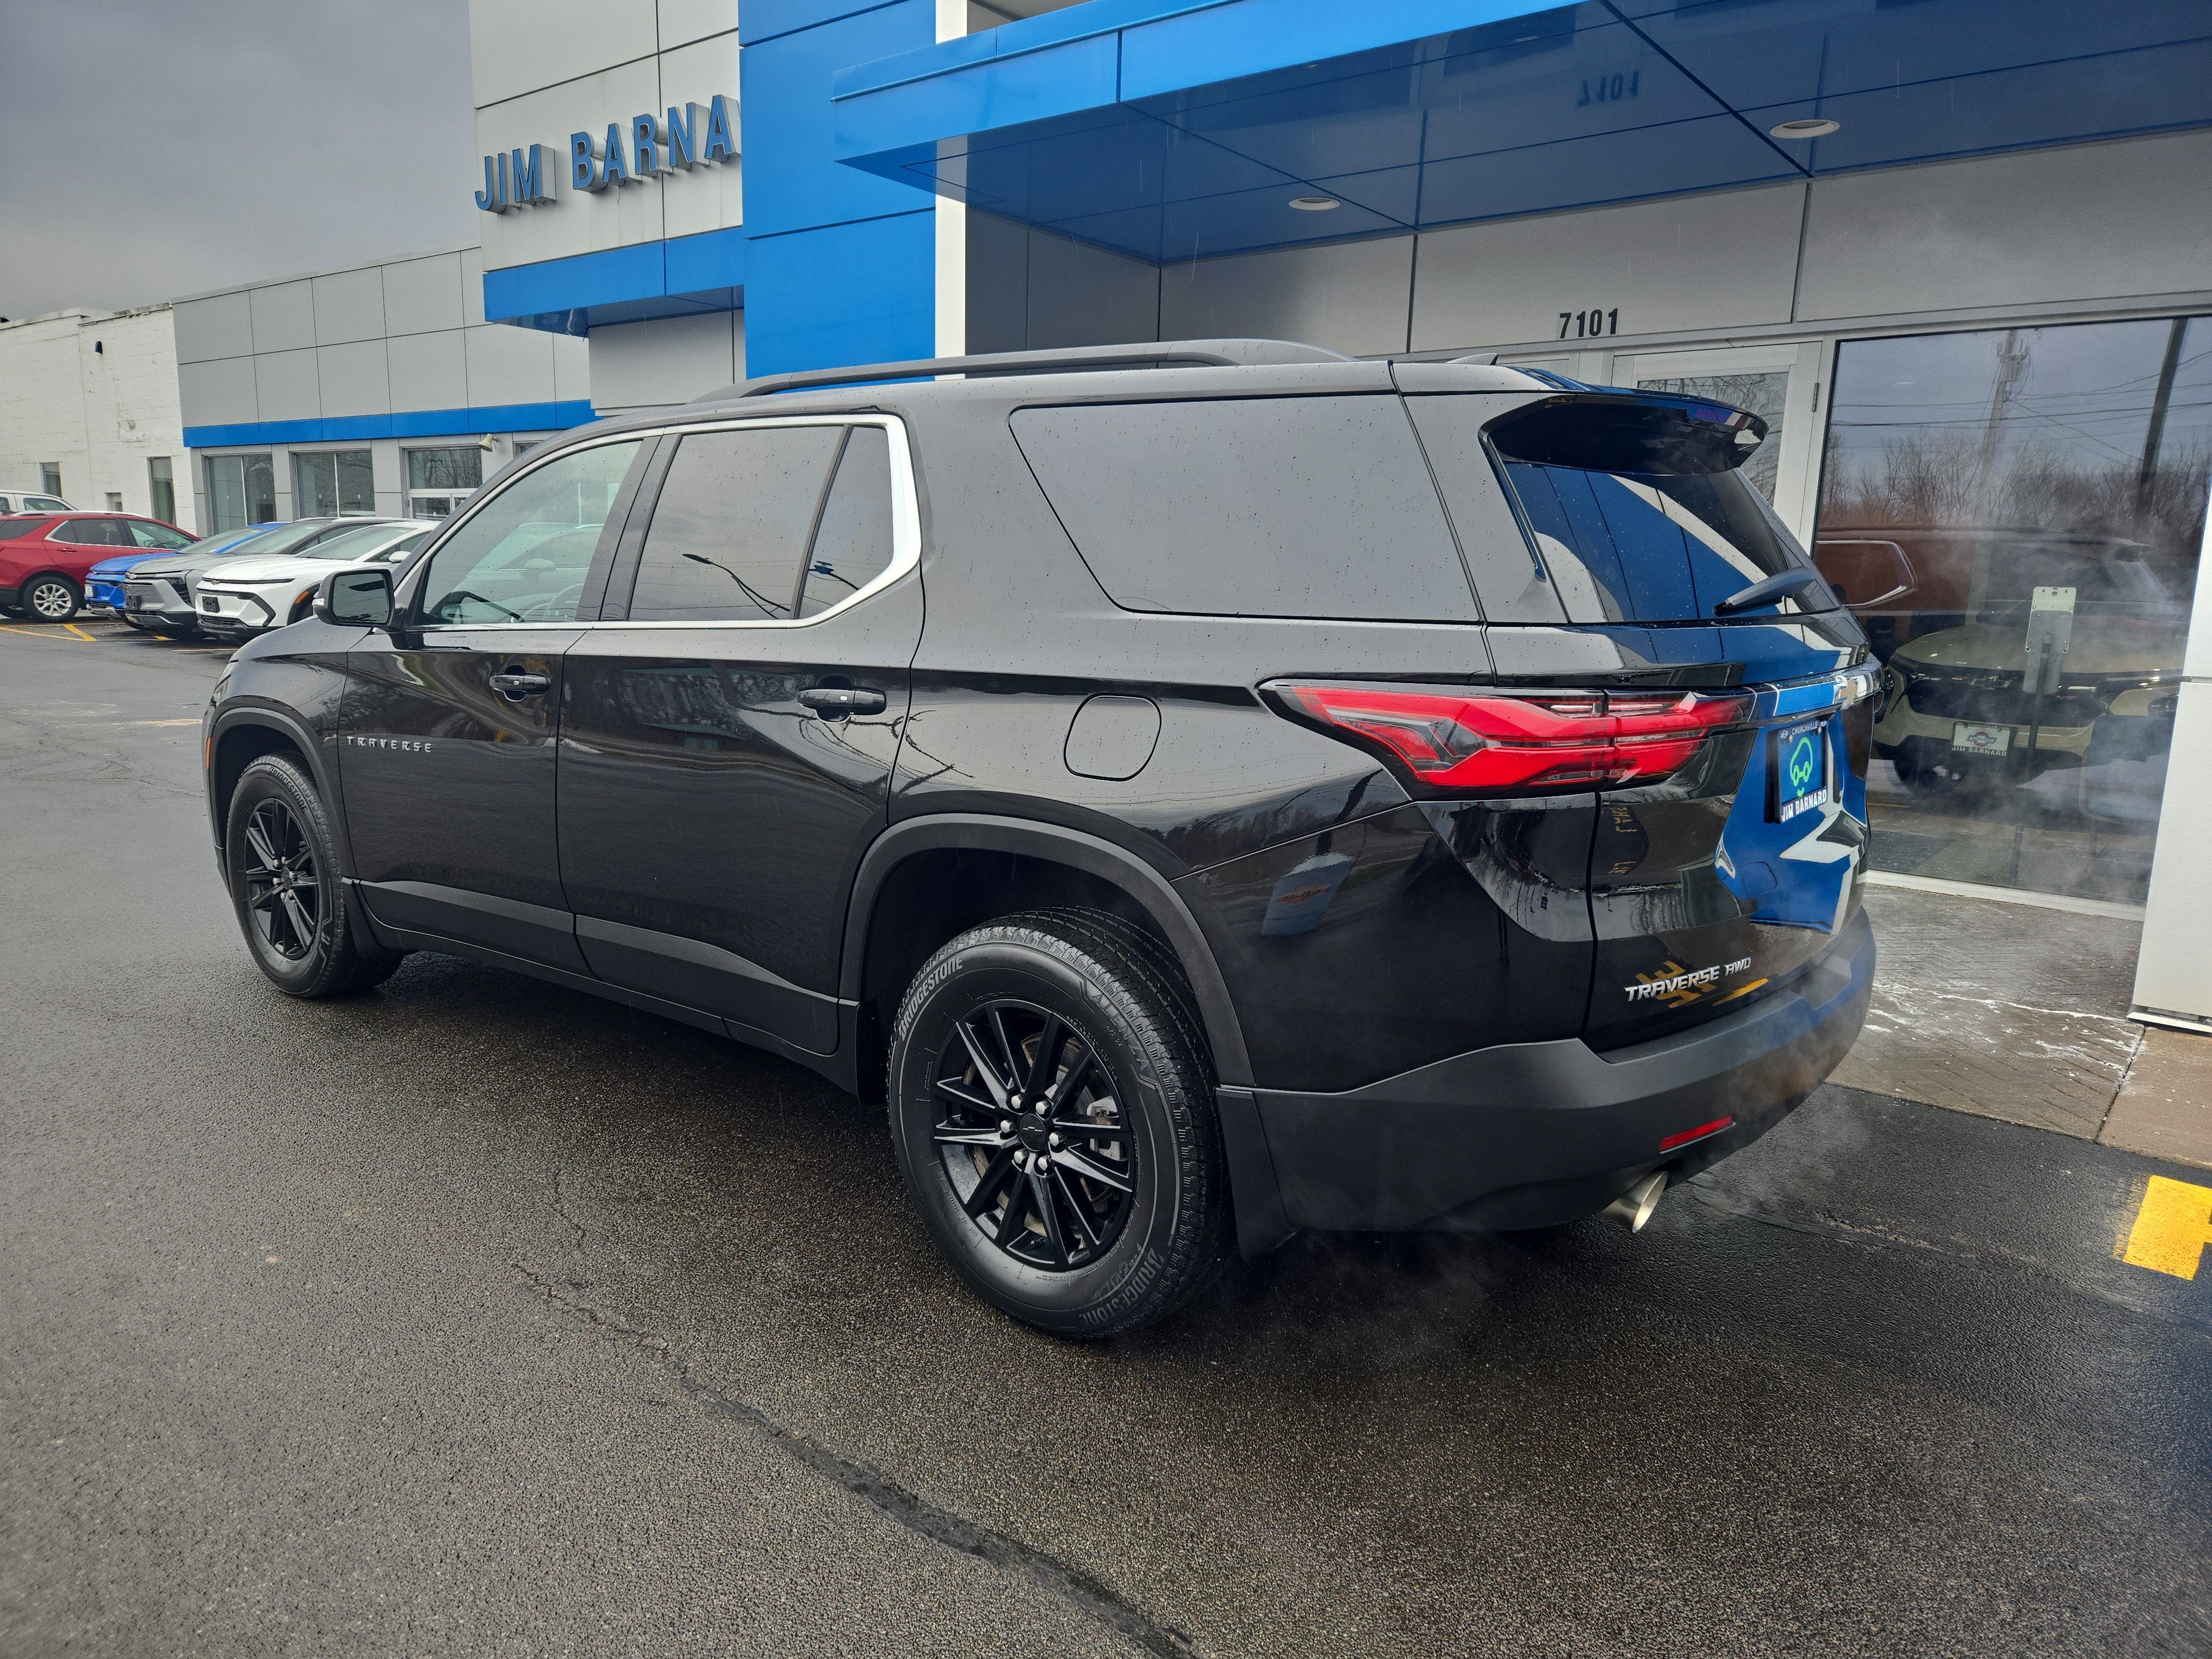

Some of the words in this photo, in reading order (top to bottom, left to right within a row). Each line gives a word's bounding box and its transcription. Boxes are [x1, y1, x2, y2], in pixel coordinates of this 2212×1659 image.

[475, 144, 549, 212] JIM
[571, 94, 737, 192] BARNA
[1559, 308, 1618, 339] 7101
[346, 736, 433, 753] TRAVERSE
[1969, 748, 2007, 757] BARNARD
[1780, 803, 1794, 822] JIM
[1795, 789, 1827, 815] BARNARD
[898, 954, 963, 1041] BRIDGESTONE
[1623, 965, 1720, 1001] TRAVERSE
[1724, 957, 1752, 976] AWD
[1090, 993, 1150, 1071] ALENZA
